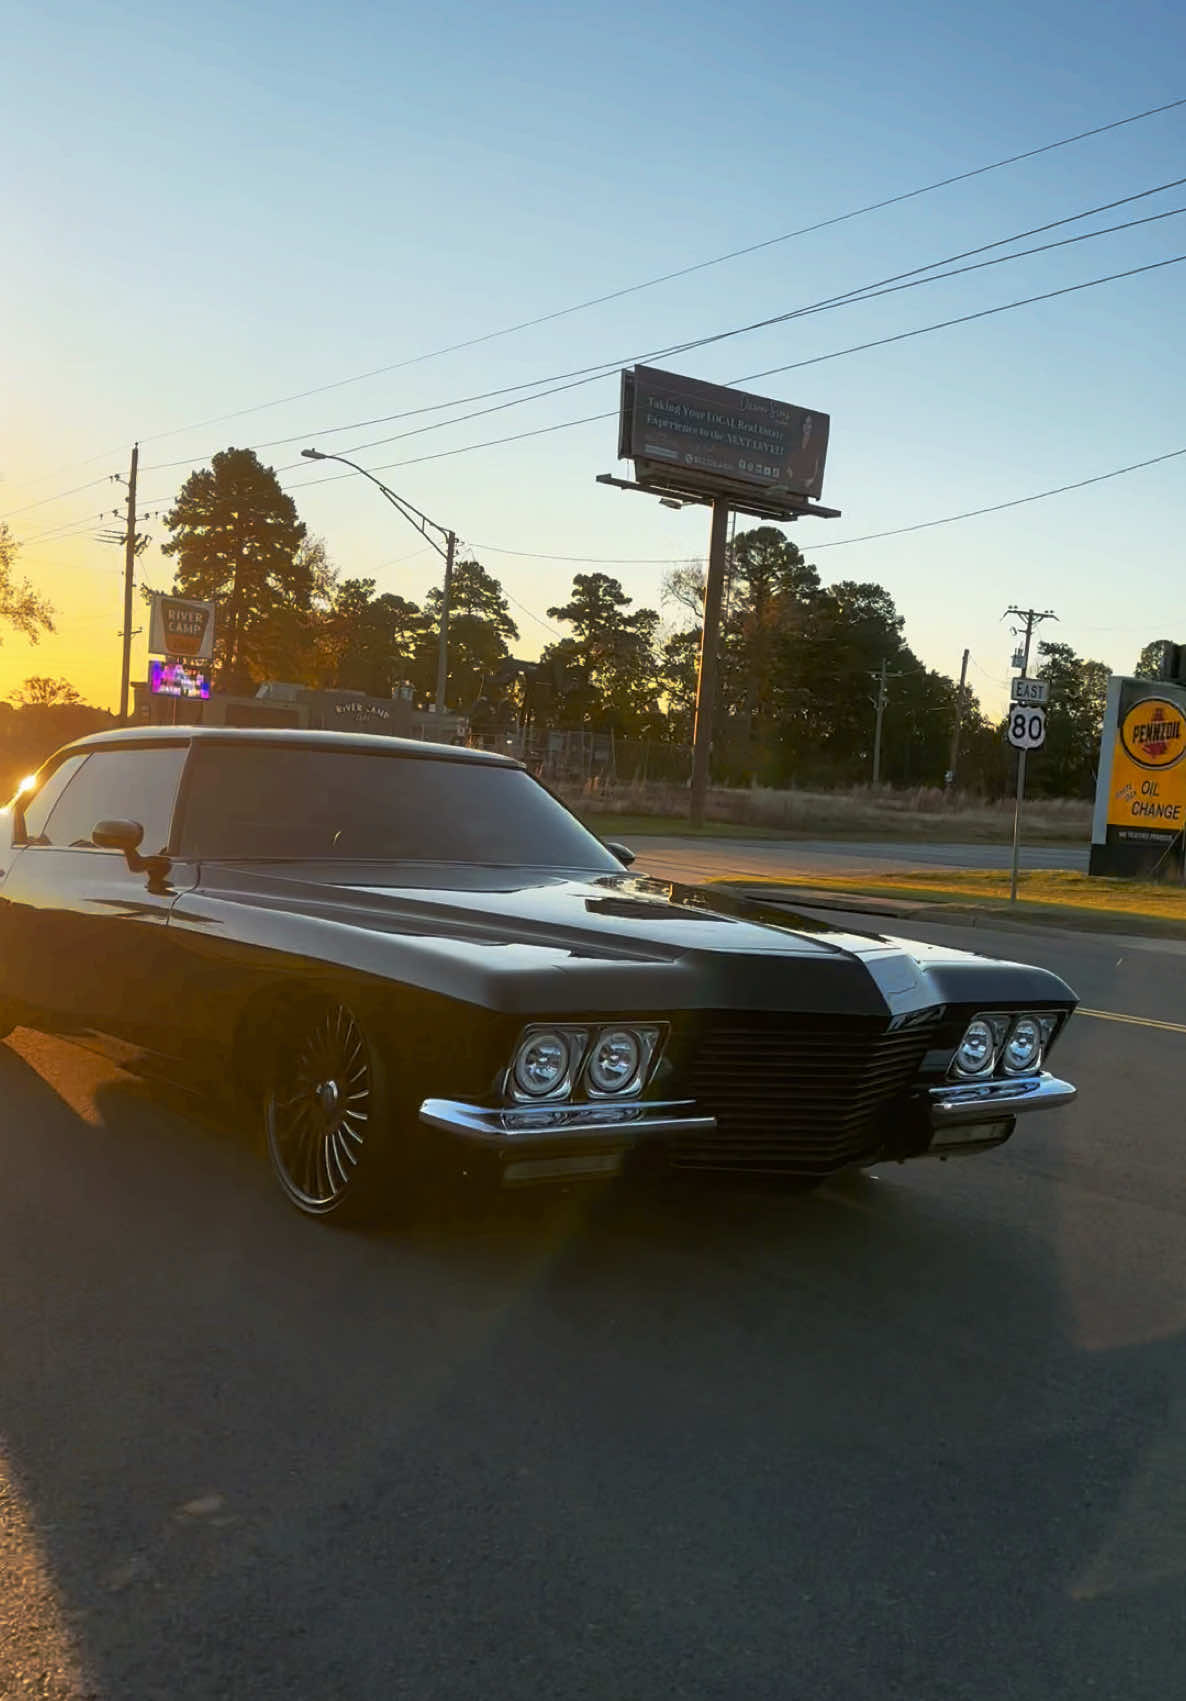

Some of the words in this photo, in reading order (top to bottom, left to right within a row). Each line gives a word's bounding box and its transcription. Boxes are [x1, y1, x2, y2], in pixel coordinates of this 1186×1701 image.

[683, 404, 706, 420] Your
[647, 414, 698, 433] Experience
[168, 608, 203, 623] RIVER
[168, 622, 201, 634] CAMP
[1016, 682, 1045, 699] EAST
[1012, 713, 1042, 740] 80
[1132, 721, 1181, 744] PENNZOIL
[1141, 780, 1160, 797] OIL
[1131, 800, 1182, 820] CHANGE
